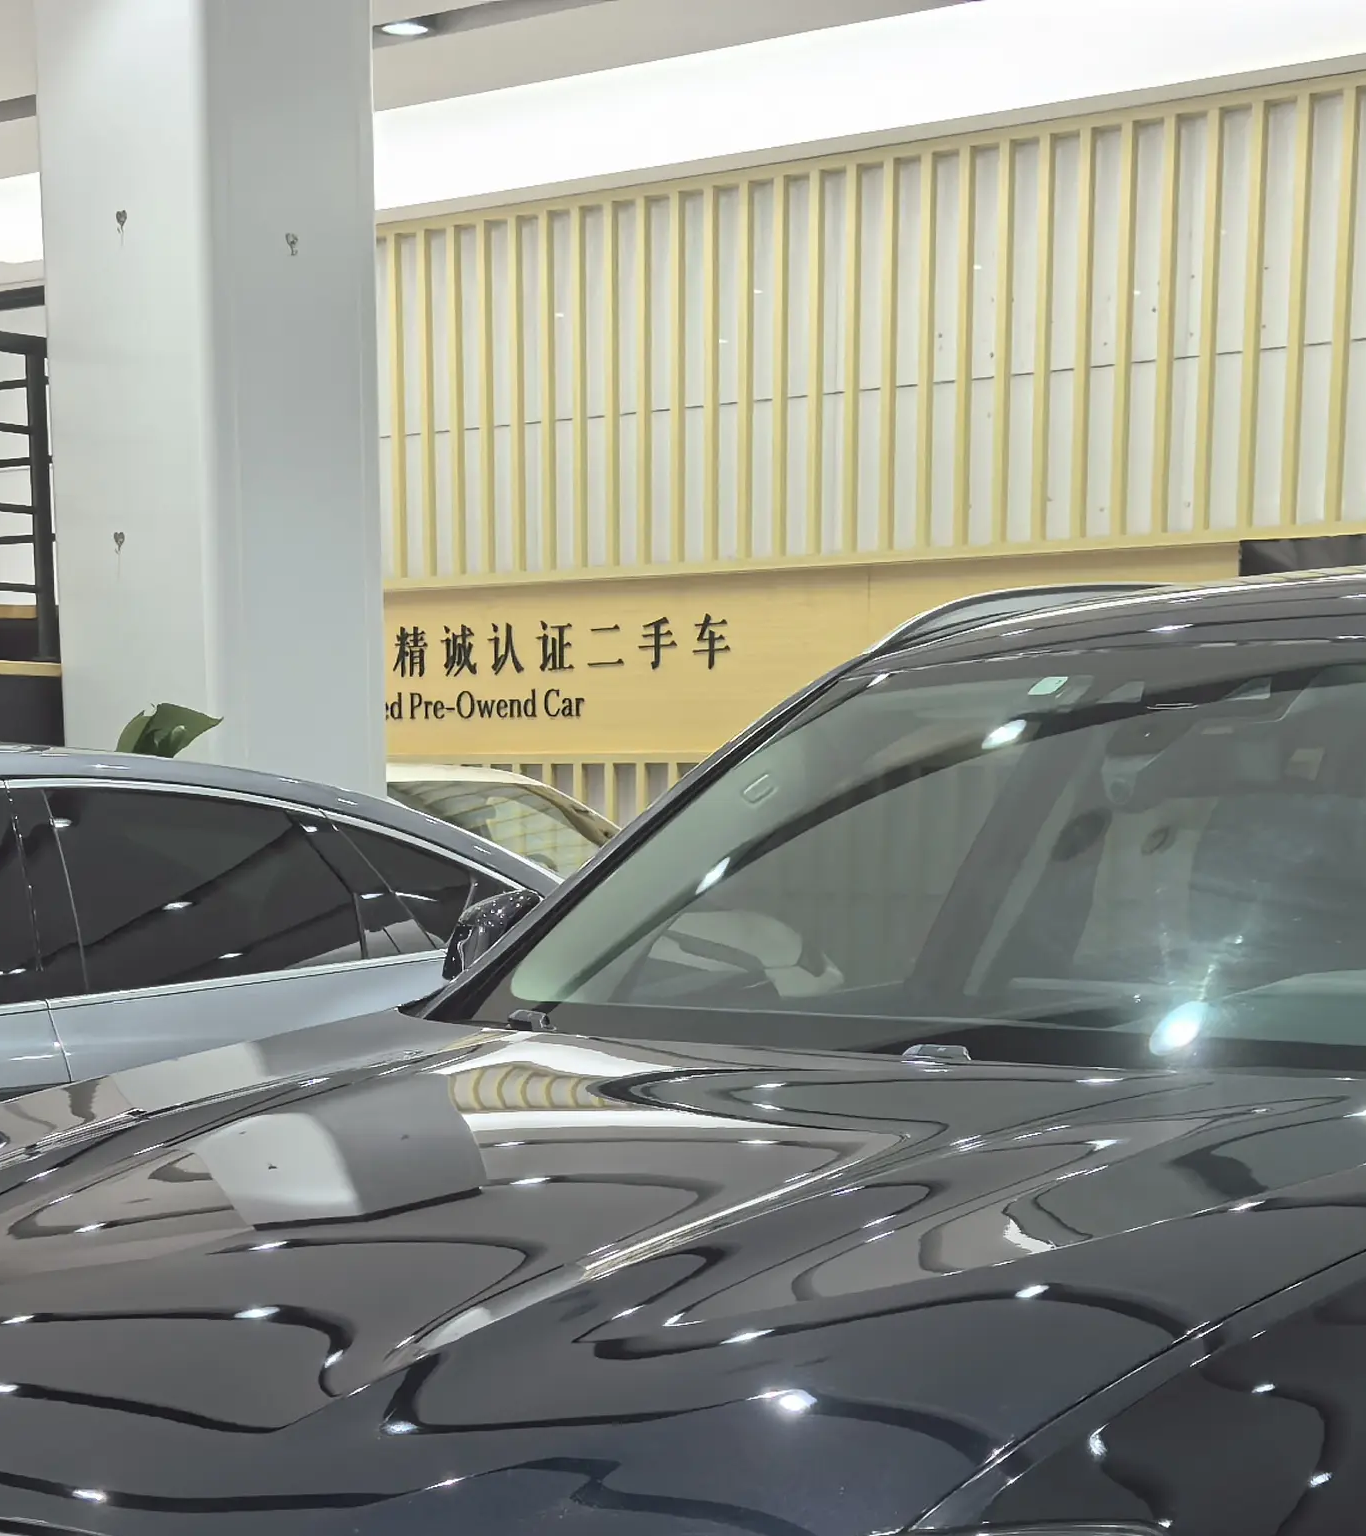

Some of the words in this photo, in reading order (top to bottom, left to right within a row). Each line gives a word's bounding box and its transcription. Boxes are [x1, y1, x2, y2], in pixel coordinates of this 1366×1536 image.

[391, 612, 732, 679] 精诚认证二手车
[409, 688, 538, 720] Pre-Owend
[543, 688, 585, 718] Car
